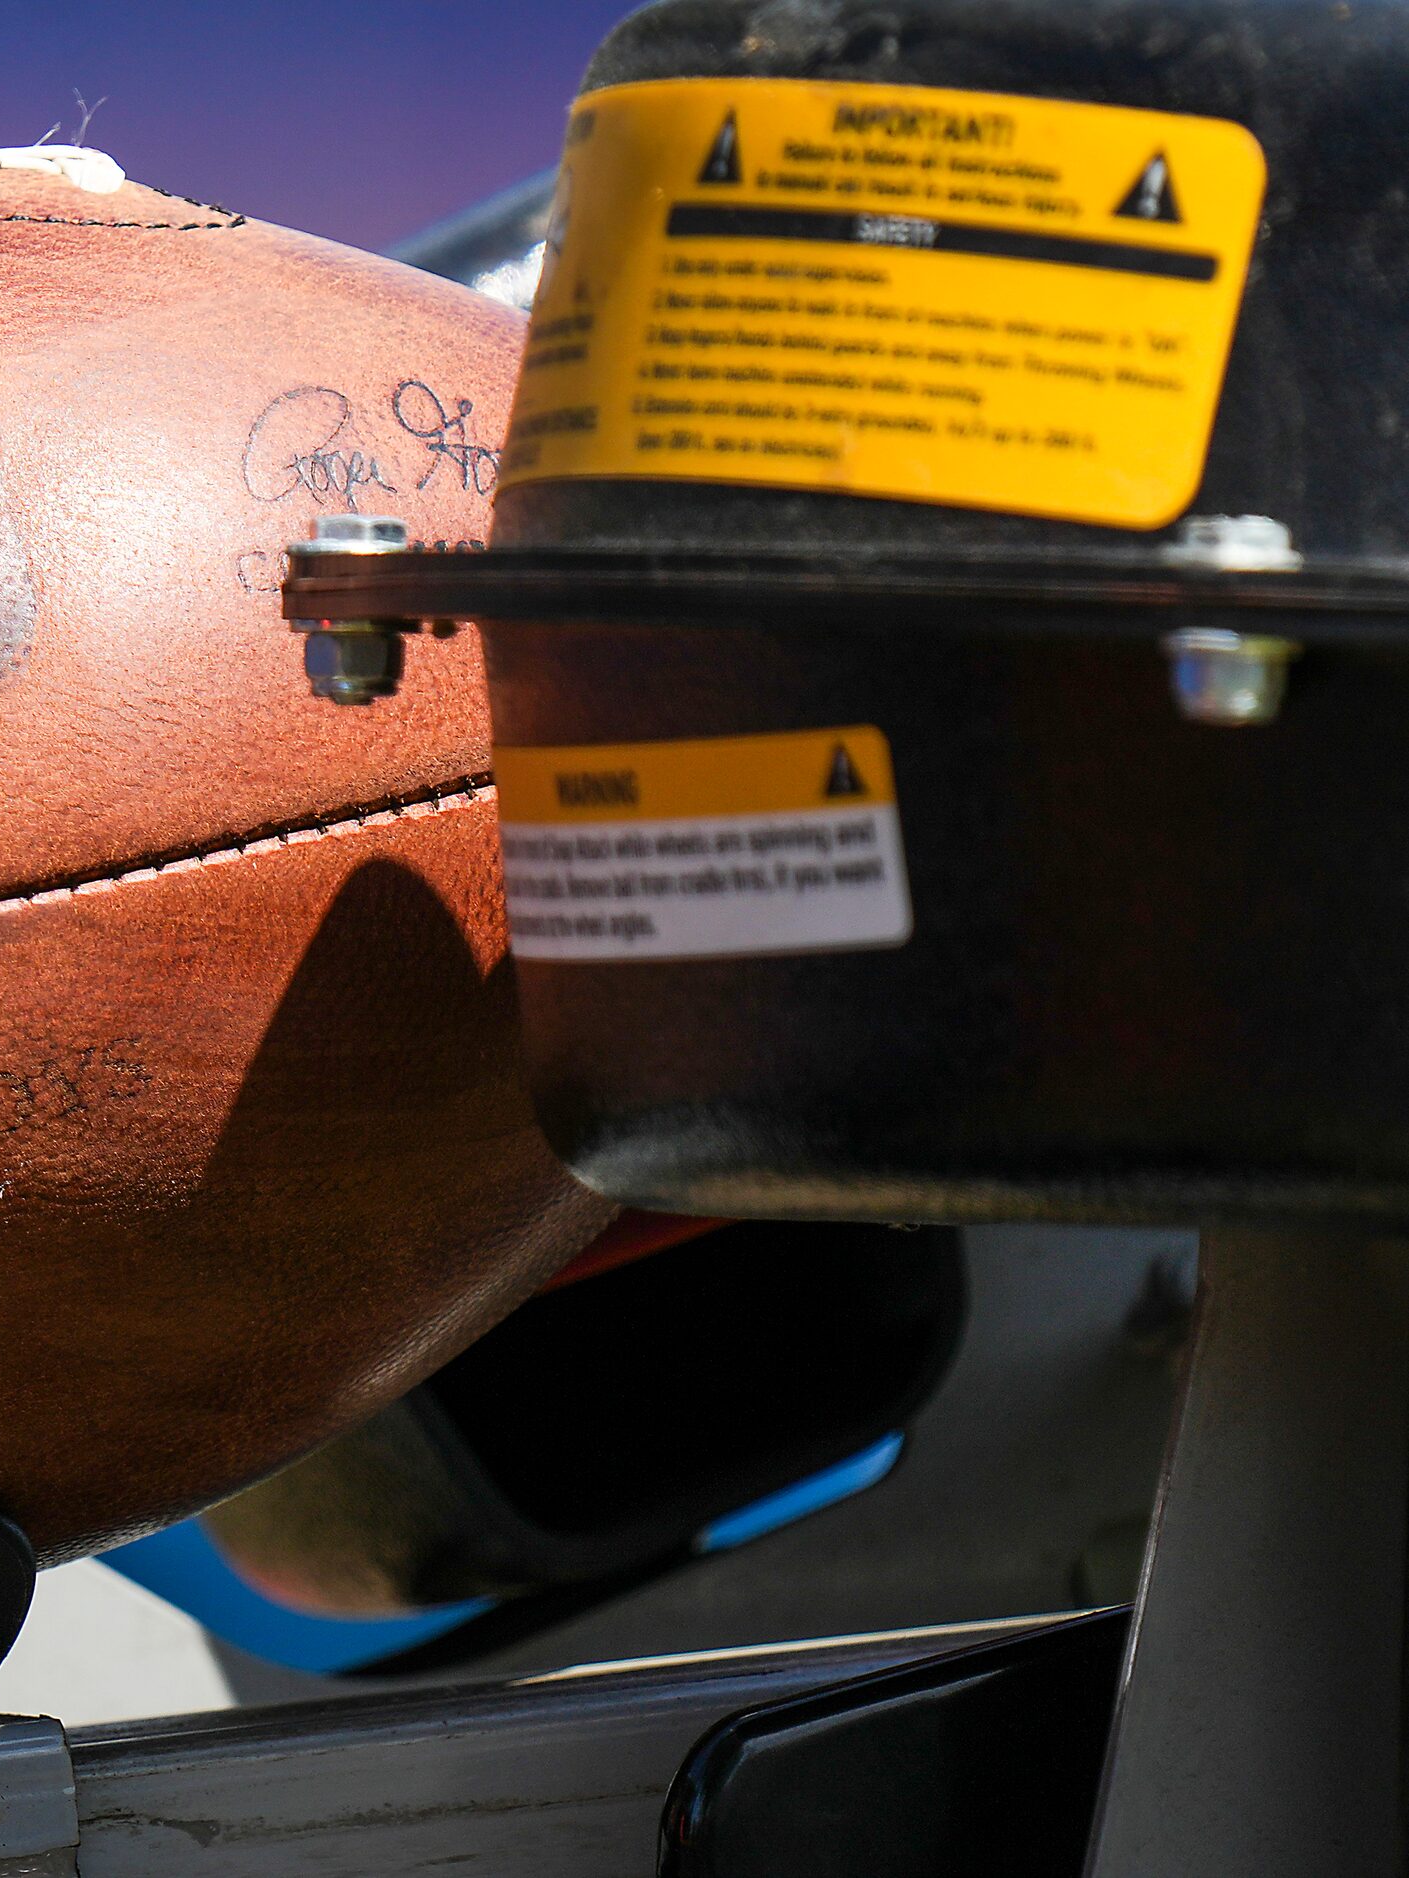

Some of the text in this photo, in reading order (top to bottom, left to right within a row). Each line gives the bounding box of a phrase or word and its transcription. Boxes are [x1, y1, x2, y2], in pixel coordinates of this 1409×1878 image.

[832, 102, 1016, 147] IMPORTANT!
[854, 213, 940, 248] SAFETY
[556, 770, 639, 807] WARNING
